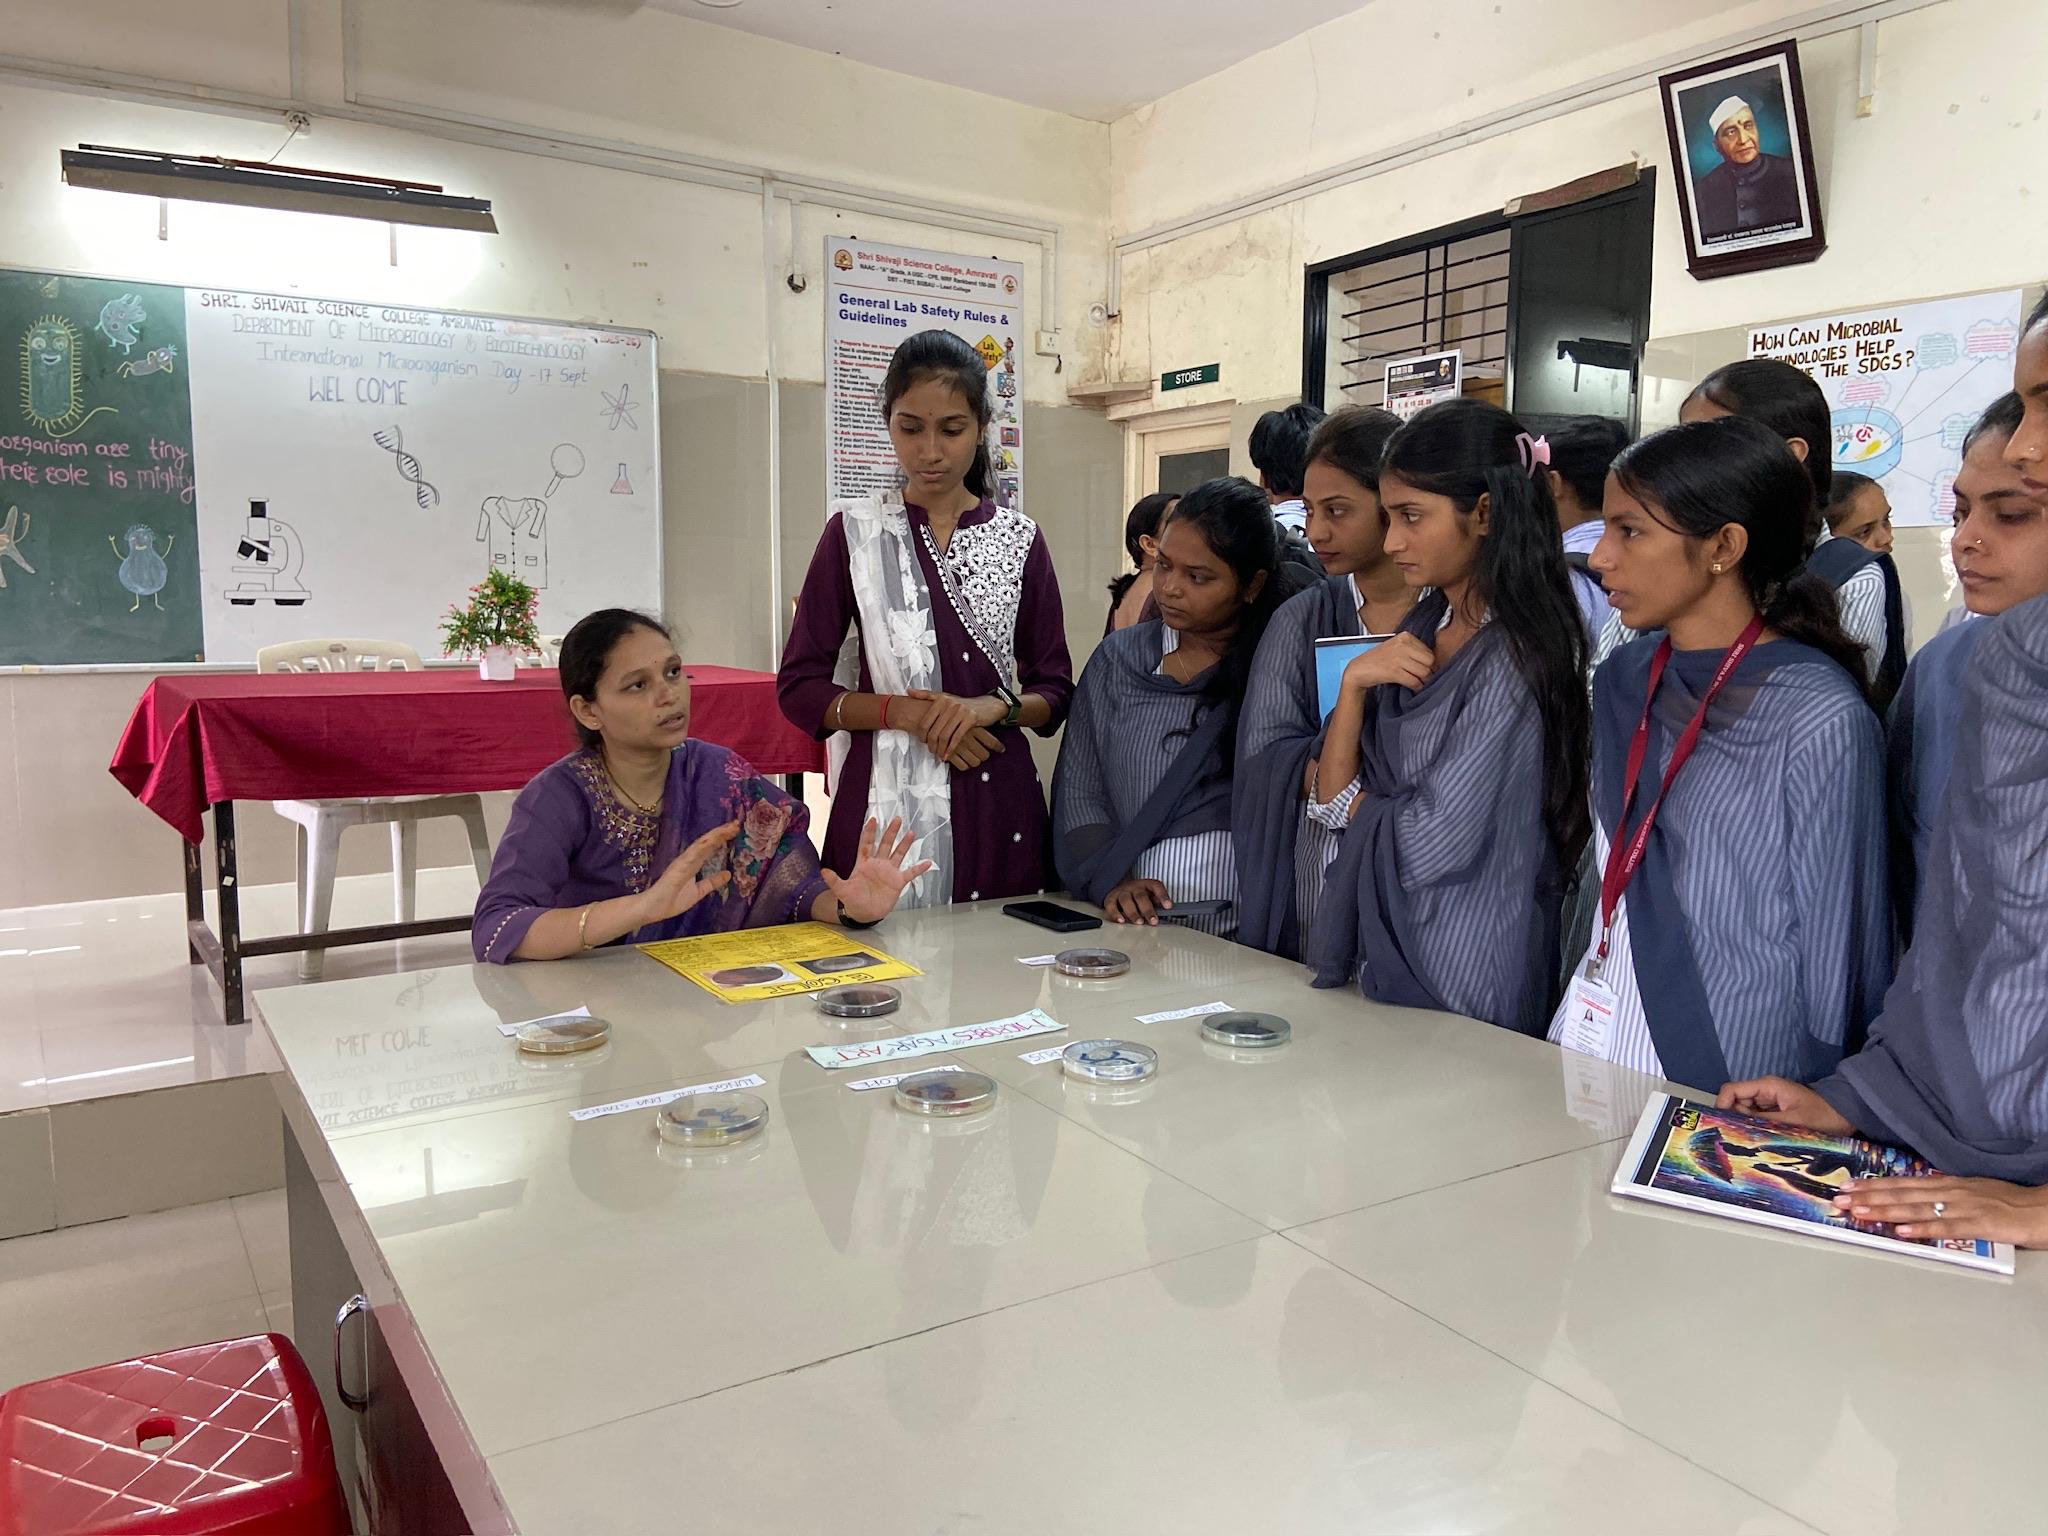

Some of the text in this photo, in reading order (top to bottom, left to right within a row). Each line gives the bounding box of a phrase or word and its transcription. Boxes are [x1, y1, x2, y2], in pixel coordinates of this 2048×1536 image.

[858, 252, 874, 260] Shri
[876, 254, 901, 266] Shivaji
[904, 258, 932, 270] Science
[966, 268, 997, 280] Amravati
[316, 301, 370, 319] SCIENCE
[382, 309, 430, 326] COLLEGE
[839, 293, 1009, 325] General Lab Safety Rules &
[839, 310, 907, 328] Guidelines
[232, 314, 316, 337] DEPARTMENT
[328, 319, 347, 340] OF
[358, 322, 455, 348] MICROBIOLOGY
[486, 336, 586, 361] BIOTECHNOLOGY
[1827, 318, 1903, 342] MICROBIAL
[1855, 339, 1895, 357] HELP
[560, 368, 589, 388] Sept
[1175, 370, 1202, 384] STORE
[1820, 362, 1848, 378] THE
[356, 377, 408, 405] COME
[149, 438, 189, 470] tiny
[108, 465, 128, 488] is
[137, 466, 195, 504] mighty
[836, 1045, 881, 1062] ART
